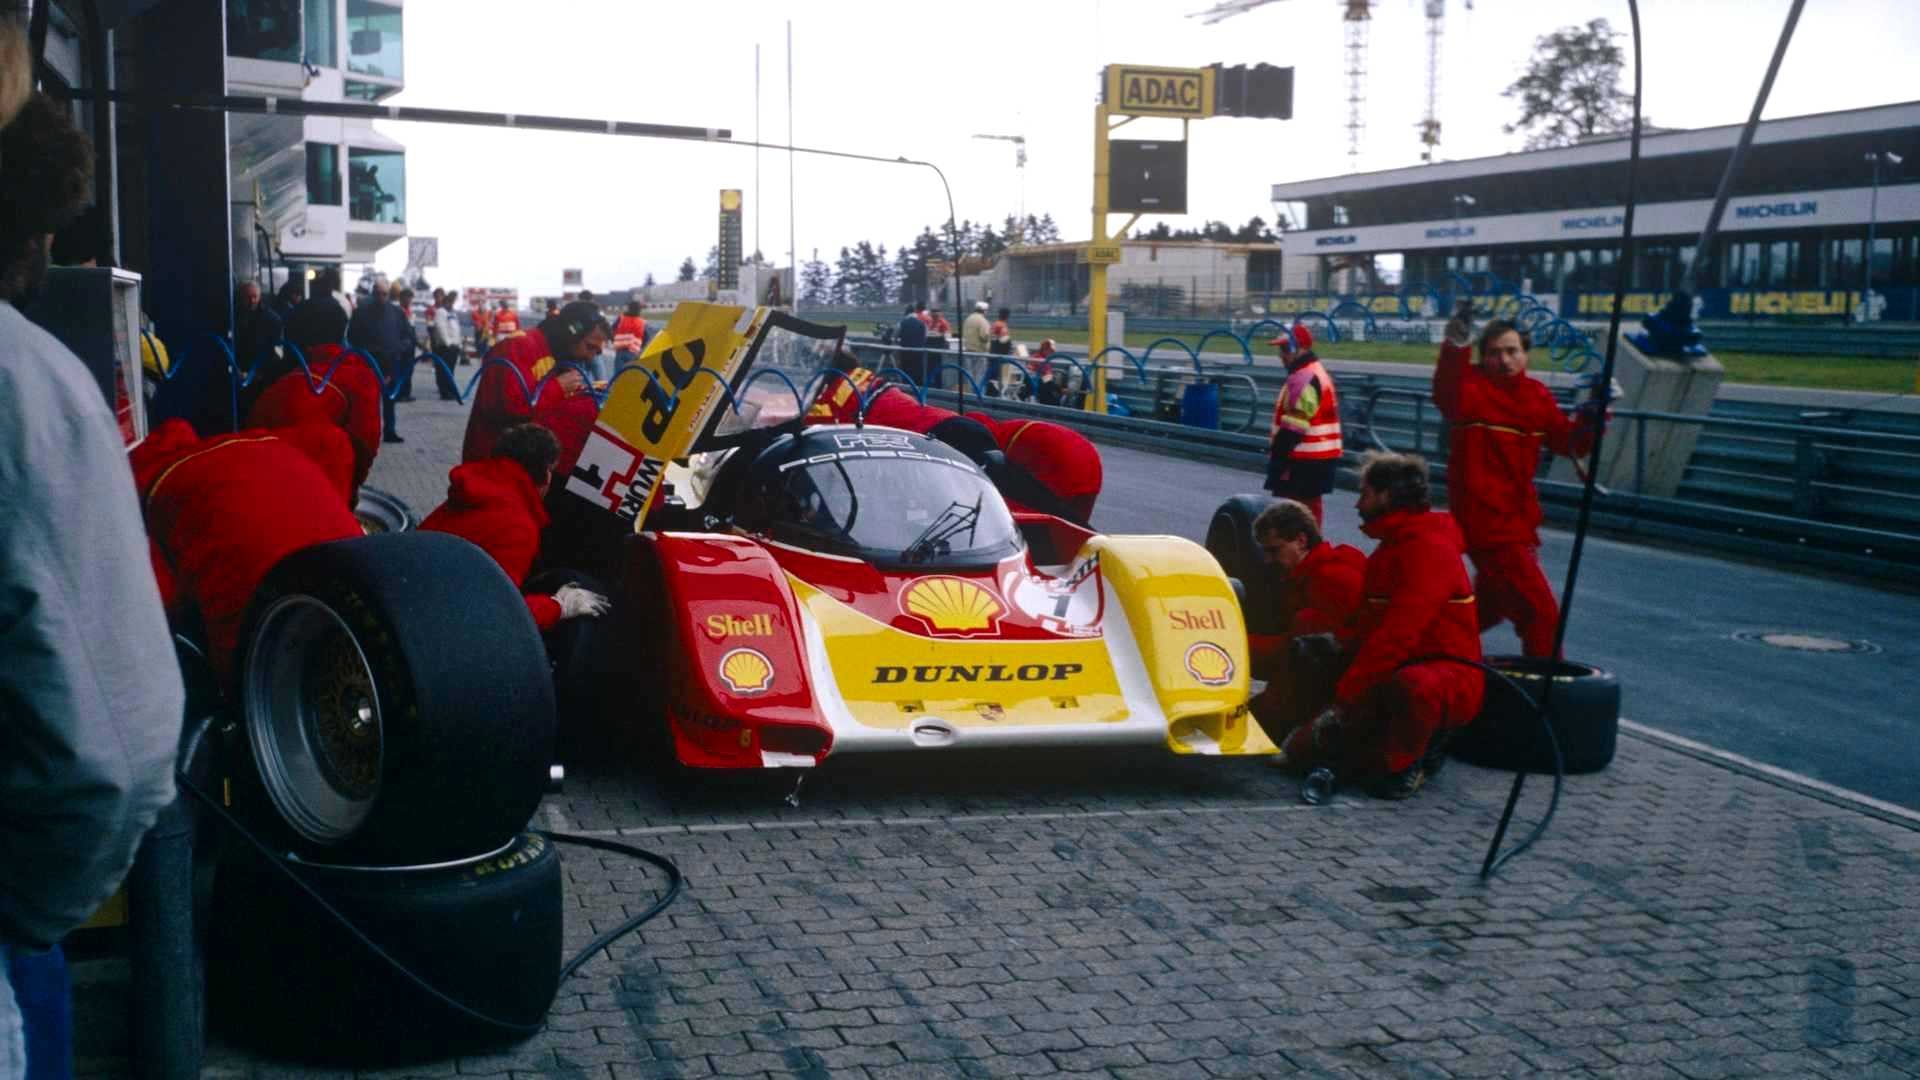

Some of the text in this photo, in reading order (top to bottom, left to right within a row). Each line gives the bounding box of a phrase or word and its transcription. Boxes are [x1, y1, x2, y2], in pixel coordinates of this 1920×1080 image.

[1126, 77, 1196, 106] ADAC
[1736, 202, 1818, 220] MICHELIN
[1562, 215, 1624, 230] MICHELIN
[570, 464, 604, 490] 1
[706, 613, 773, 638] Shell
[1169, 609, 1226, 631] Shell
[871, 663, 1083, 684] DUNLOP
